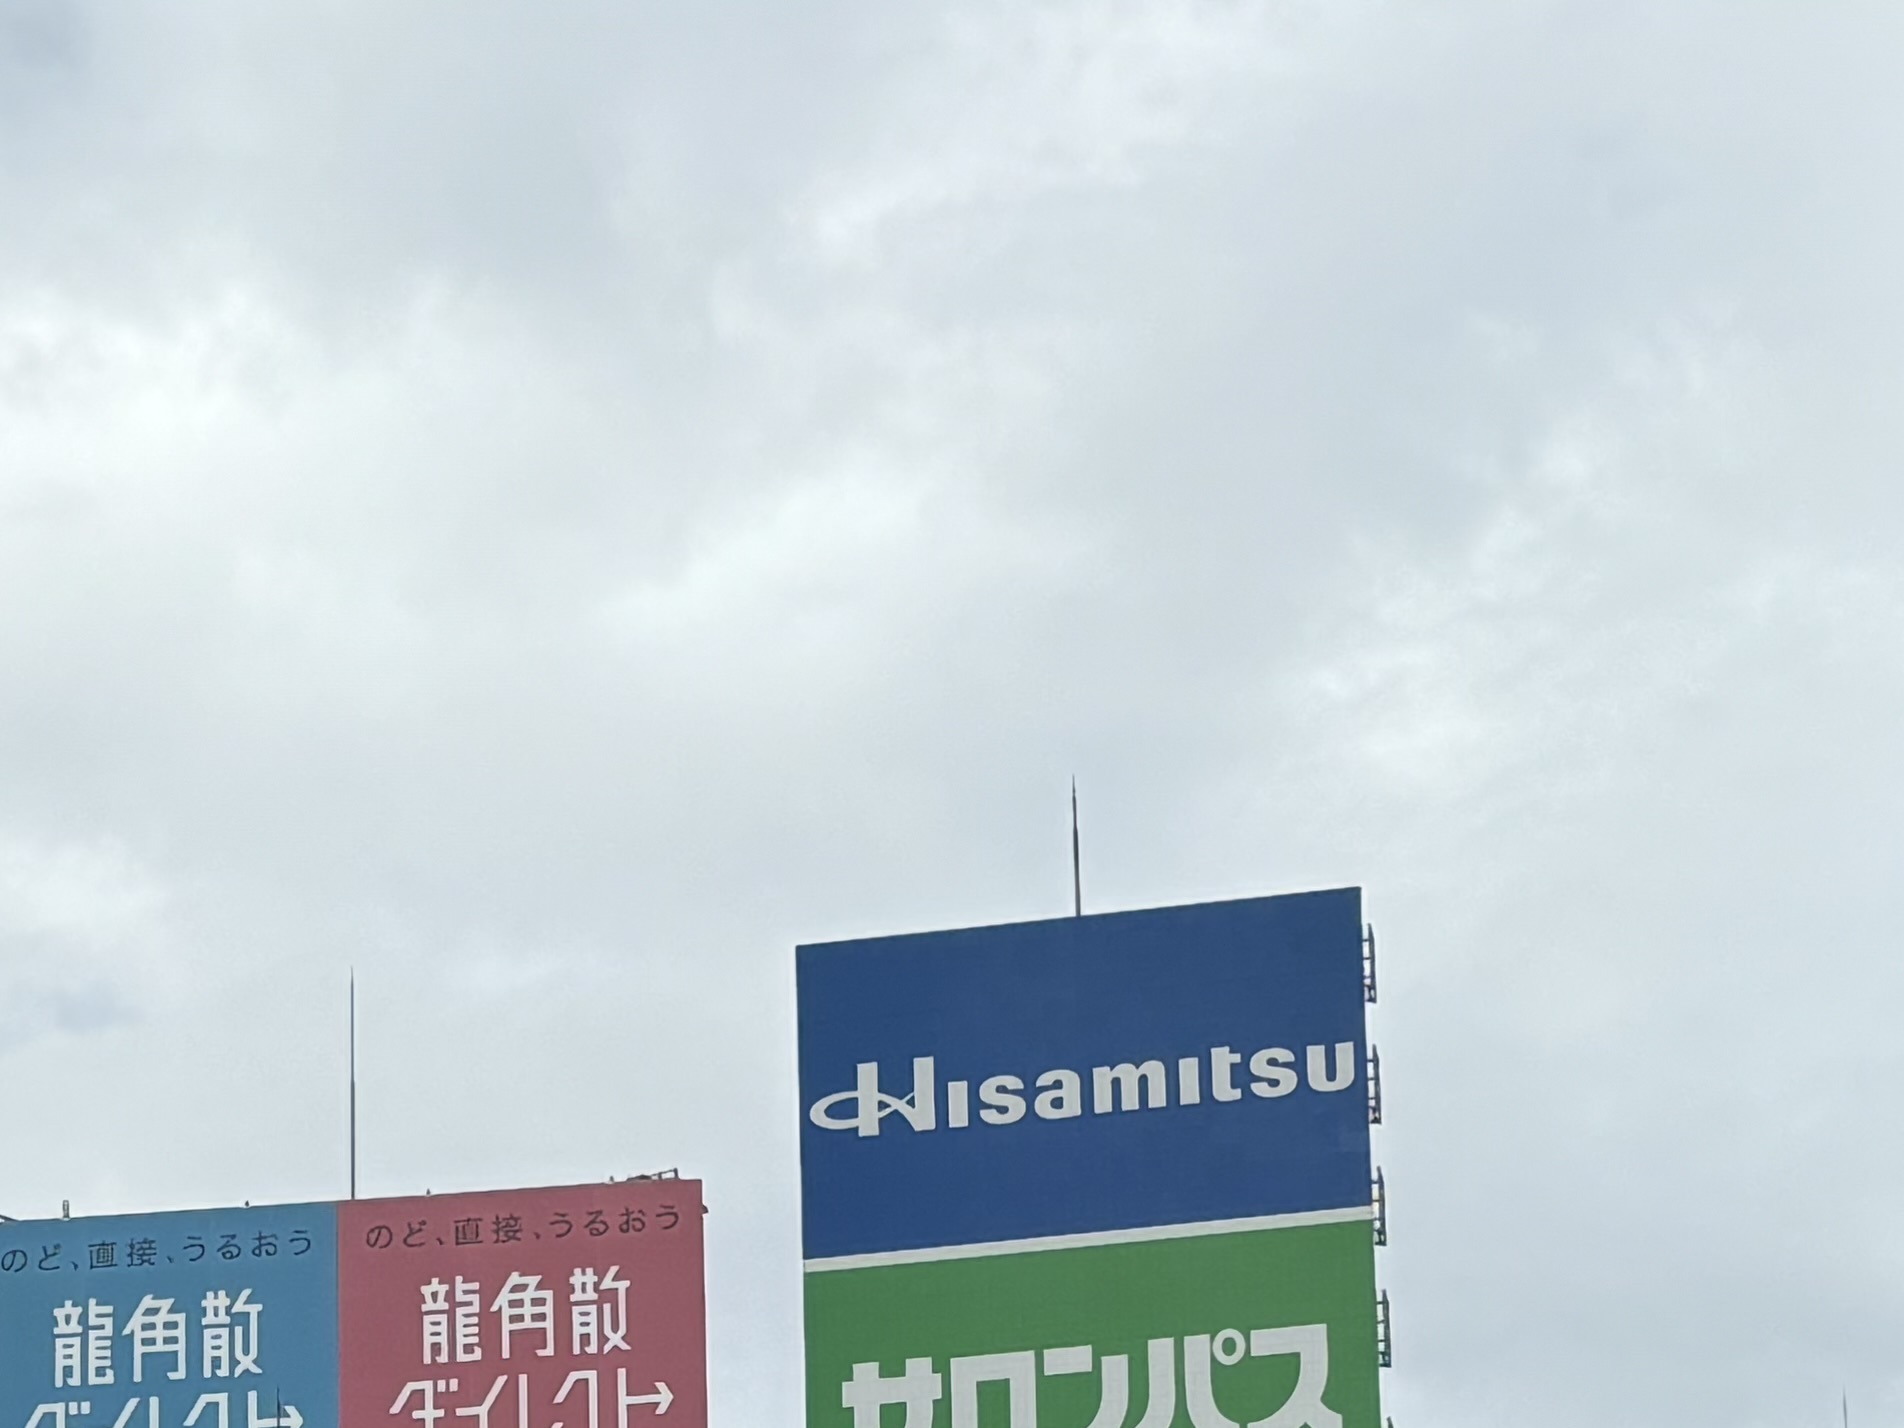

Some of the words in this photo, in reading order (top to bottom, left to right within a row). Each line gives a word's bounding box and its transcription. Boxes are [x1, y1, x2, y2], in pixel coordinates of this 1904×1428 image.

[809, 1041, 1357, 1137] Hisamitsu
[0, 1229, 314, 1274] のど、直接、うるおう
[365, 1202, 682, 1251] のど、直接、うるおう
[52, 1288, 264, 1389] 龍角散
[421, 1265, 632, 1365] 龍角散
